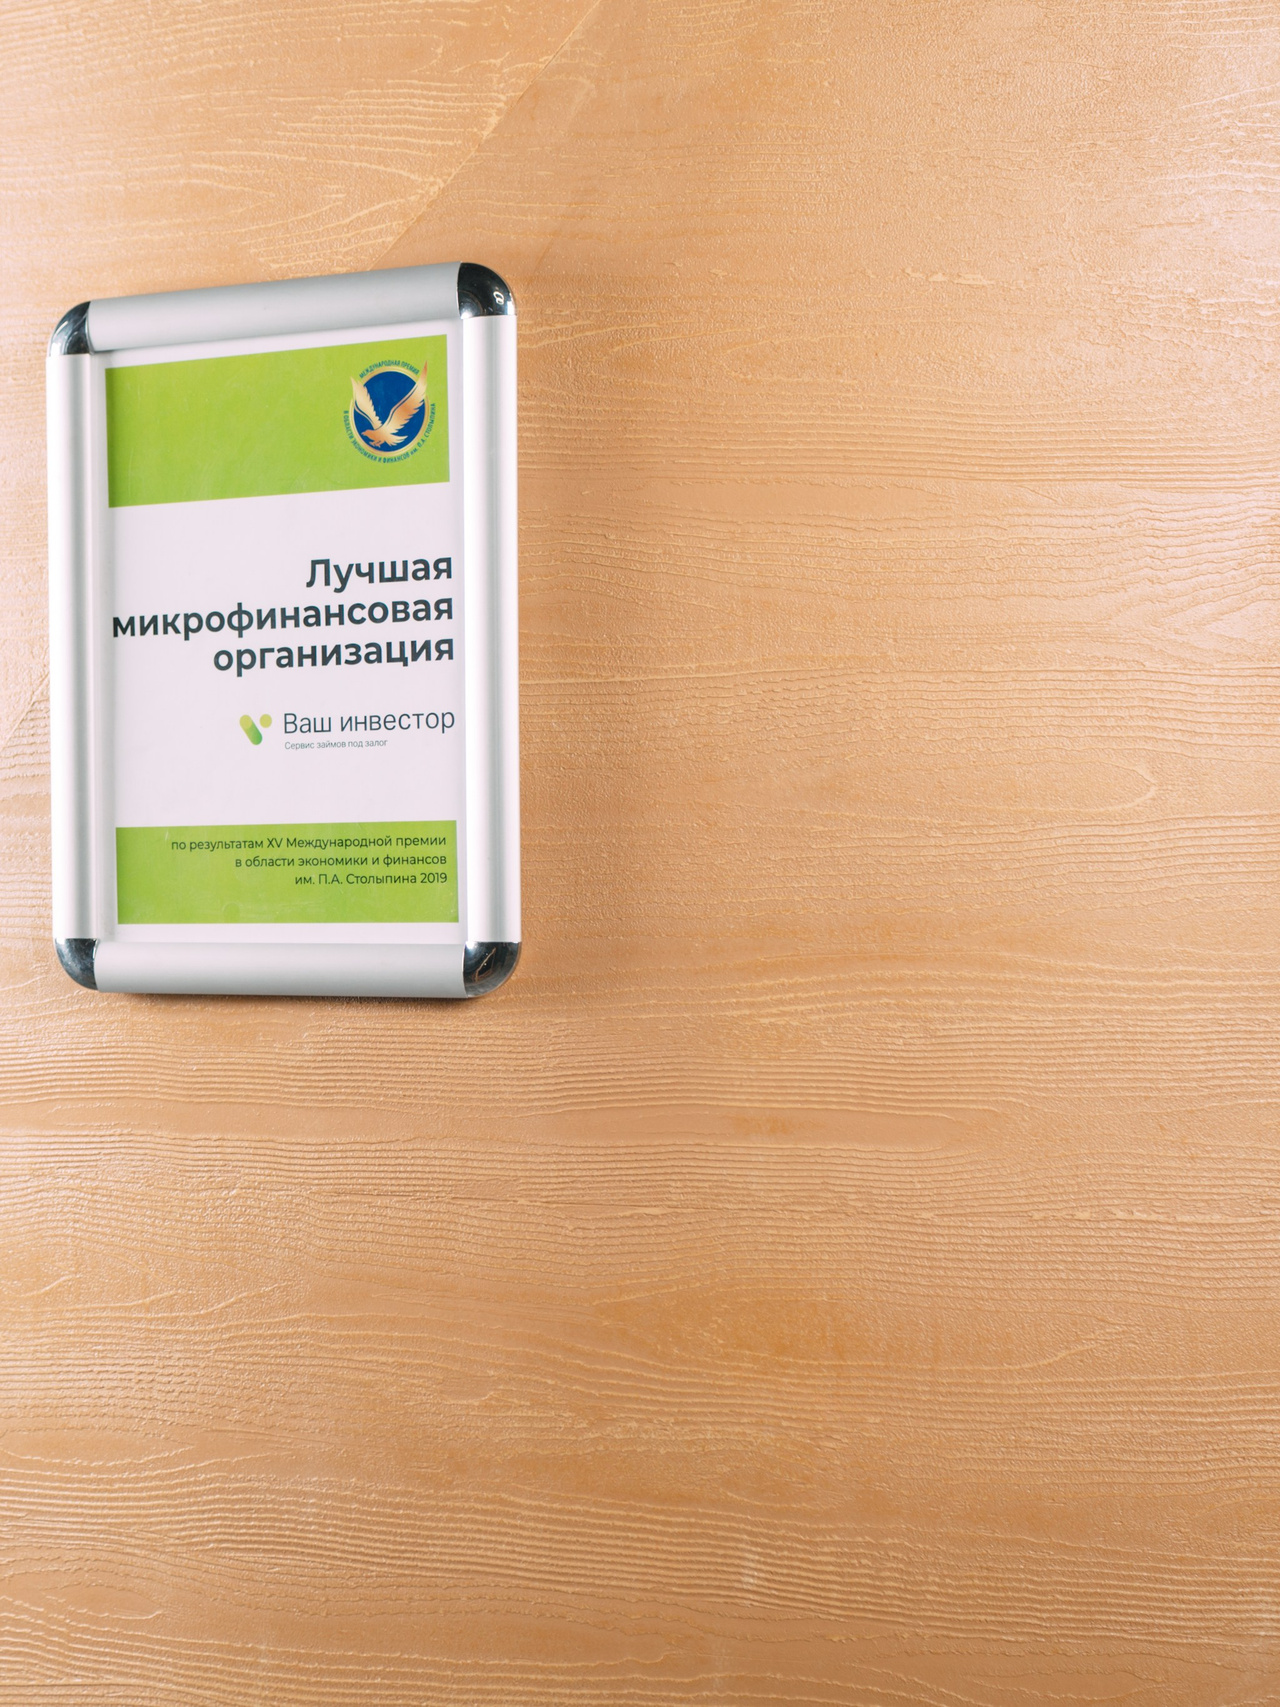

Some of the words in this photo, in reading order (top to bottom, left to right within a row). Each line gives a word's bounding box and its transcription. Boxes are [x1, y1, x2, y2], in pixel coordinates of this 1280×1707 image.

[306, 557, 452, 593] Лучшая
[112, 597, 453, 641] микрофинансовая
[214, 638, 454, 677] организация
[284, 713, 331, 734] Ваш
[340, 711, 455, 734] инвестор
[284, 741, 315, 751] Сервис
[316, 740, 347, 749] займов
[348, 740, 363, 748] под
[365, 739, 388, 747] залог
[171, 840, 186, 851] по
[189, 839, 264, 852] результатам
[266, 838, 283, 848] XV
[286, 835, 393, 850] Международной
[396, 836, 446, 847] премии
[235, 858, 242, 867] в
[245, 856, 295, 867] области
[298, 856, 368, 867] экономики
[371, 856, 380, 866] и
[383, 853, 447, 867] финансов
[295, 876, 315, 885] им.
[318, 874, 343, 885] П.А.
[346, 873, 417, 885] Столыпина
[420, 872, 448, 884] 2019
